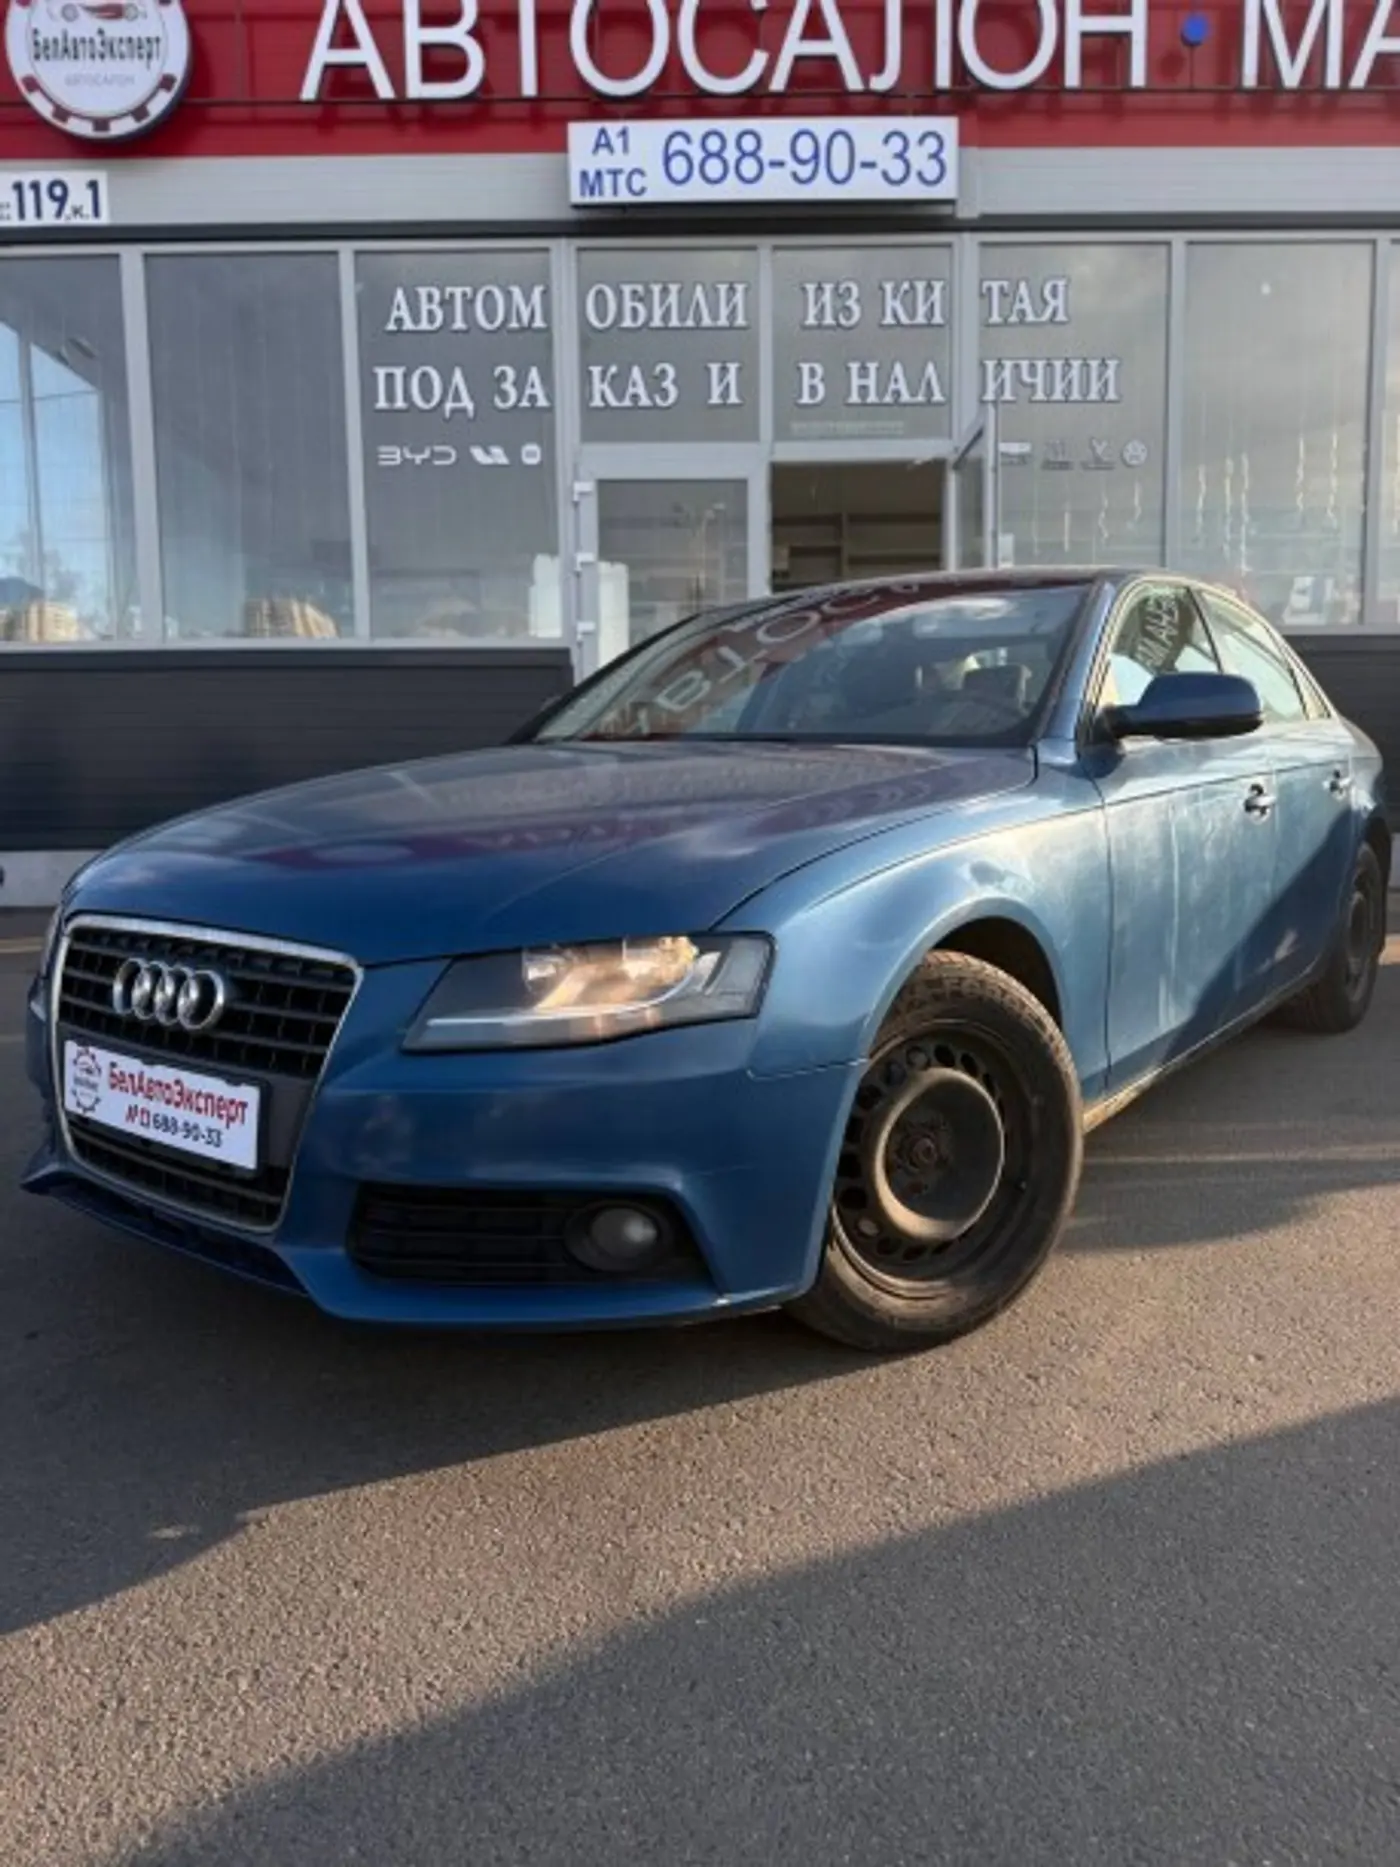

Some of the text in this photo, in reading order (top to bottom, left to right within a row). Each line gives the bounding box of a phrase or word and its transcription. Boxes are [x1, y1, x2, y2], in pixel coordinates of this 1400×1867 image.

[33, 27, 160, 70] БелАвтоЭксперт
[301, 0, 1147, 101] АВТОСАЛОН
[579, 168, 648, 198] МТС
[662, 129, 947, 186] 688-90-33
[801, 279, 863, 328] ИЗ
[373, 365, 476, 419] ПОД
[707, 361, 742, 406] И
[797, 361, 826, 405] В
[108, 1060, 249, 1130] БелАвтоЭксперт
